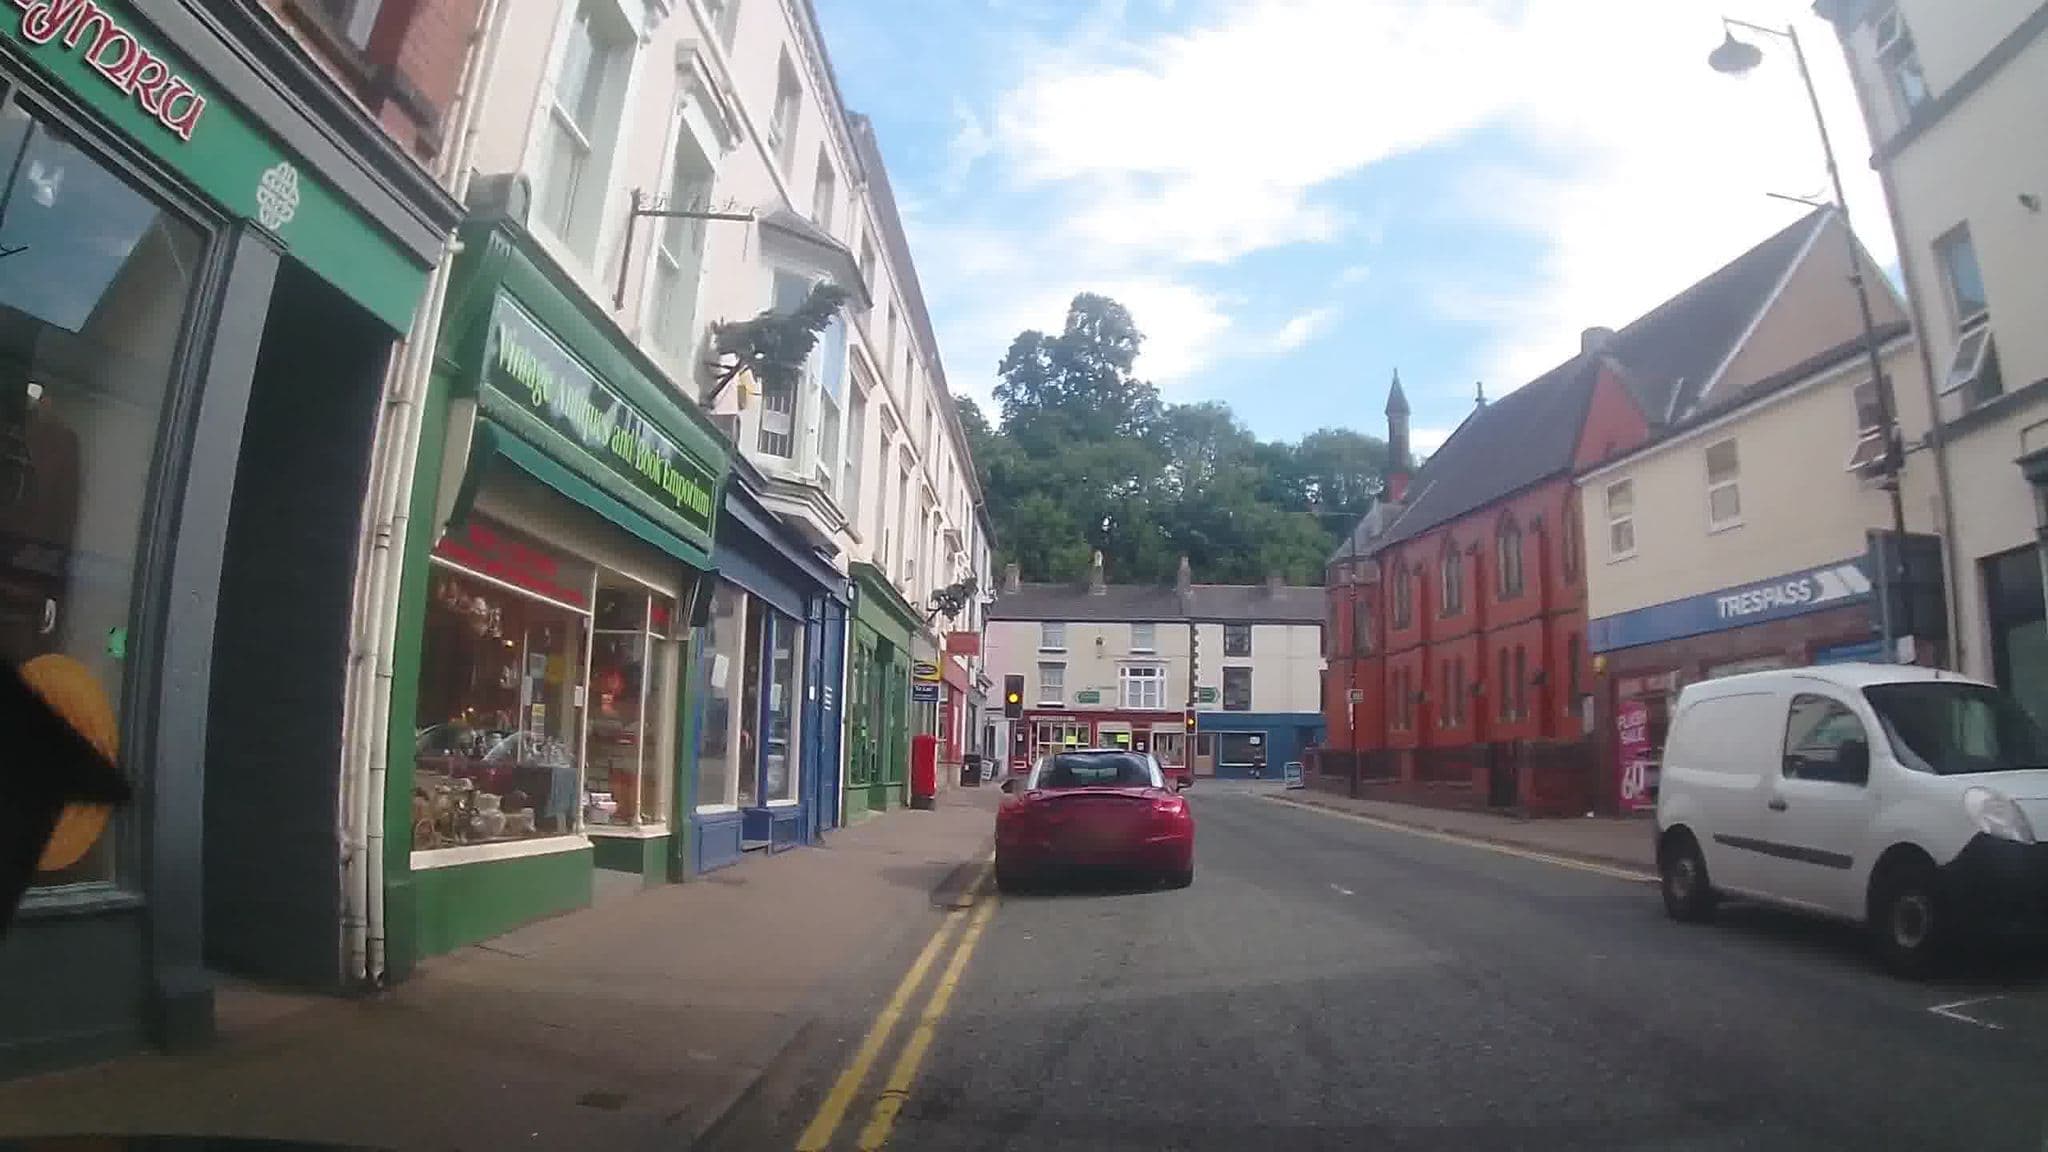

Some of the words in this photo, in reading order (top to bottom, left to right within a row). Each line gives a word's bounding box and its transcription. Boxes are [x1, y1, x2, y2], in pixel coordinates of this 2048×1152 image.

[612, 425, 635, 467] and
[634, 435, 666, 486] Book
[662, 458, 711, 518] Emporium
[1718, 579, 1813, 619] TRESPASS
